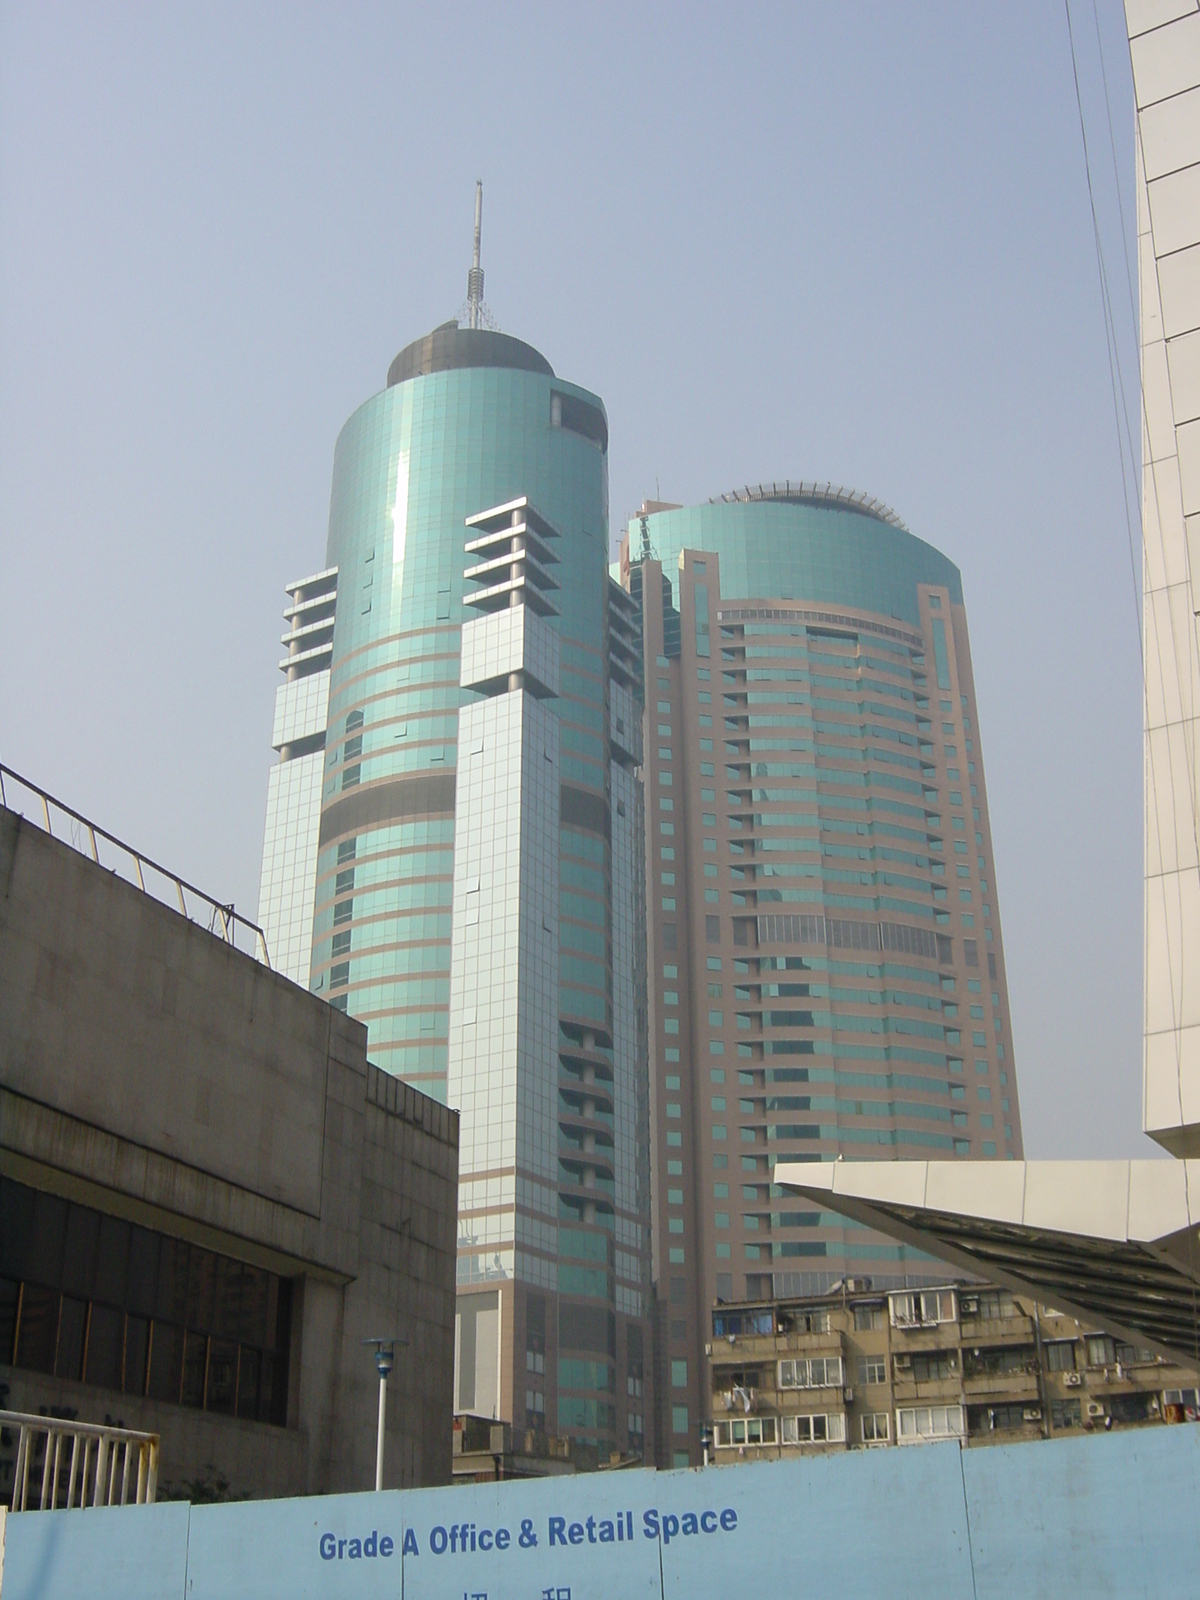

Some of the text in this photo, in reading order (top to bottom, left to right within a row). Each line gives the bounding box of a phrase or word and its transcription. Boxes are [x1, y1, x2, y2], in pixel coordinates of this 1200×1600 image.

[319, 1508, 738, 1561] Grade A Office & Retail Space
